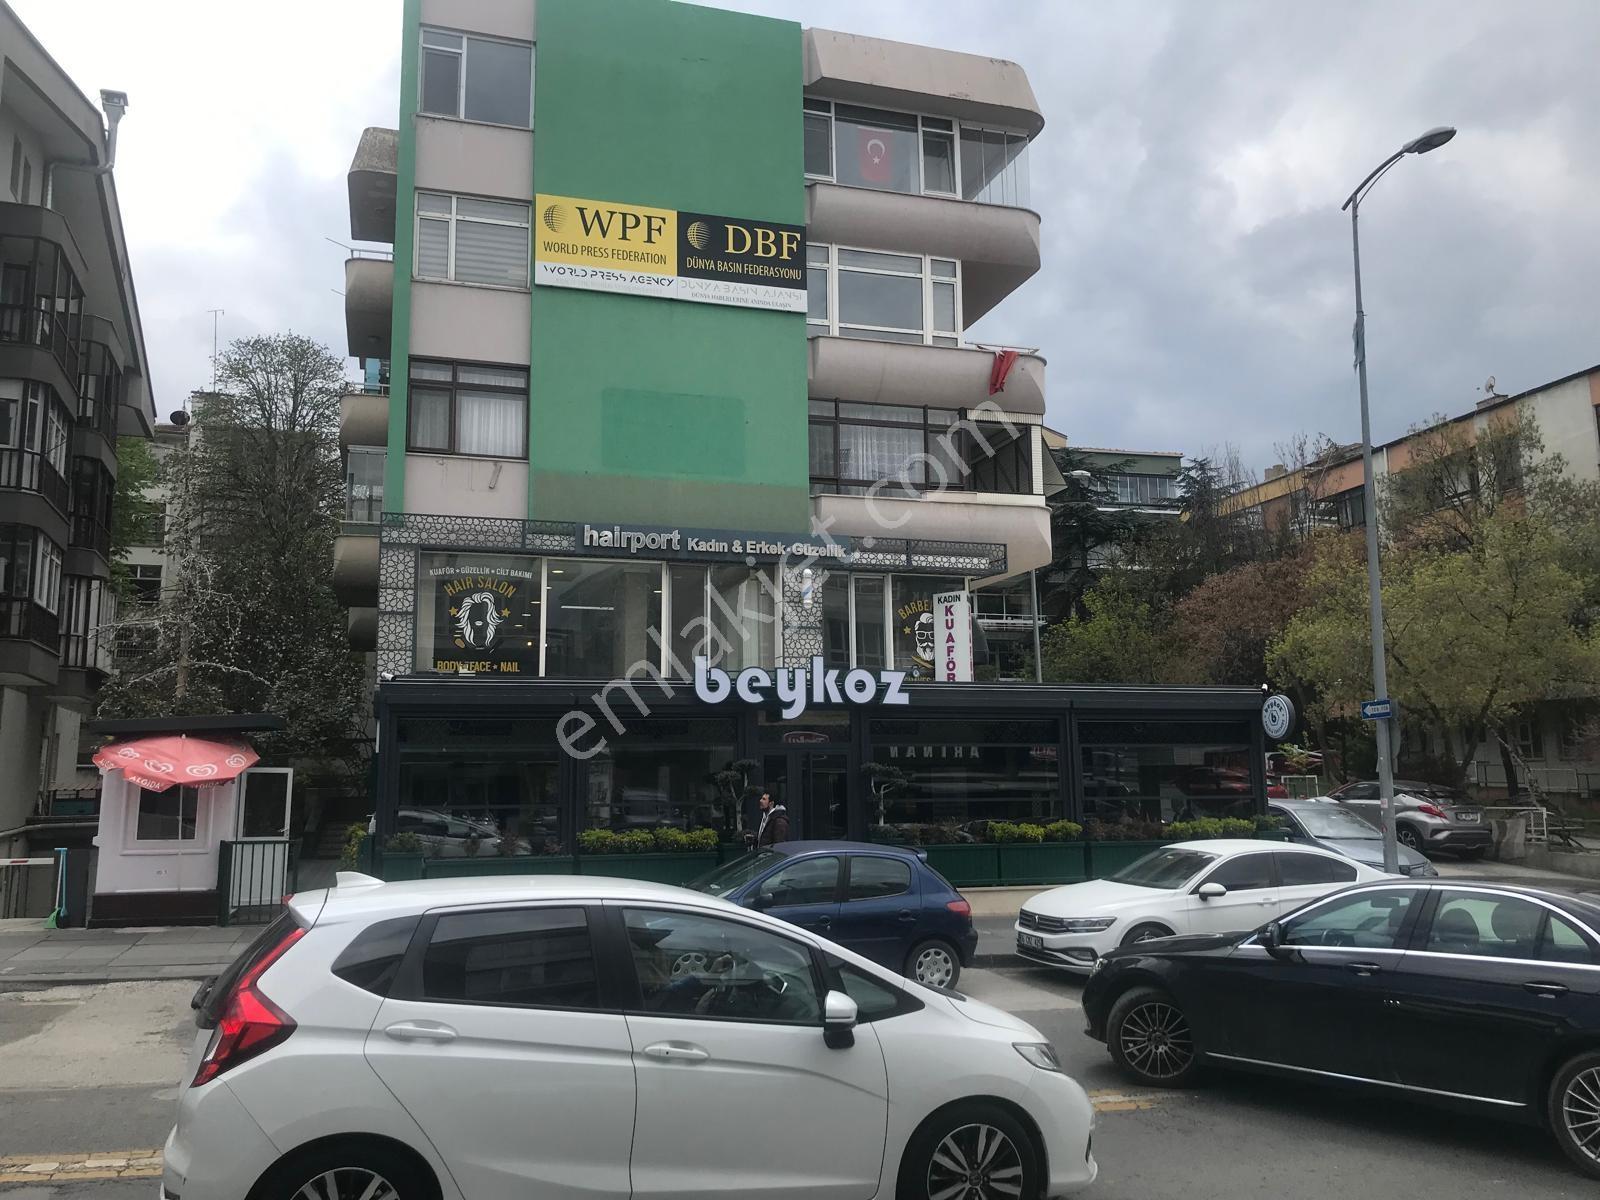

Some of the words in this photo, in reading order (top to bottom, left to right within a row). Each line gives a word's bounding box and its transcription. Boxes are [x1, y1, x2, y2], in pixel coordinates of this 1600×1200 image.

[576, 206, 666, 244] WPF
[543, 241, 578, 256] WORLD
[581, 244, 609, 259] PRESS
[611, 247, 667, 265] FEDERATION
[724, 224, 801, 260] DBF
[544, 264, 587, 277] WORLD
[590, 269, 626, 283] PRESS
[630, 274, 674, 288] AGENCY
[686, 256, 715, 271] DÜNYA
[717, 261, 742, 274] BASIN
[744, 263, 801, 280] FEDERASYONU
[583, 524, 680, 552] hairport
[687, 538, 728, 553] Kadın
[732, 540, 743, 554] &
[746, 540, 786, 555] Erkek
[792, 543, 846, 558] Güzellik
[444, 576, 474, 597] HAIR
[477, 576, 517, 598] SALON
[897, 599, 932, 620] BARBE
[937, 594, 961, 605] KADIN
[437, 661, 462, 672] BODY
[469, 661, 491, 672] FACE
[500, 661, 521, 673] NAIL
[694, 656, 910, 720] beykoz
